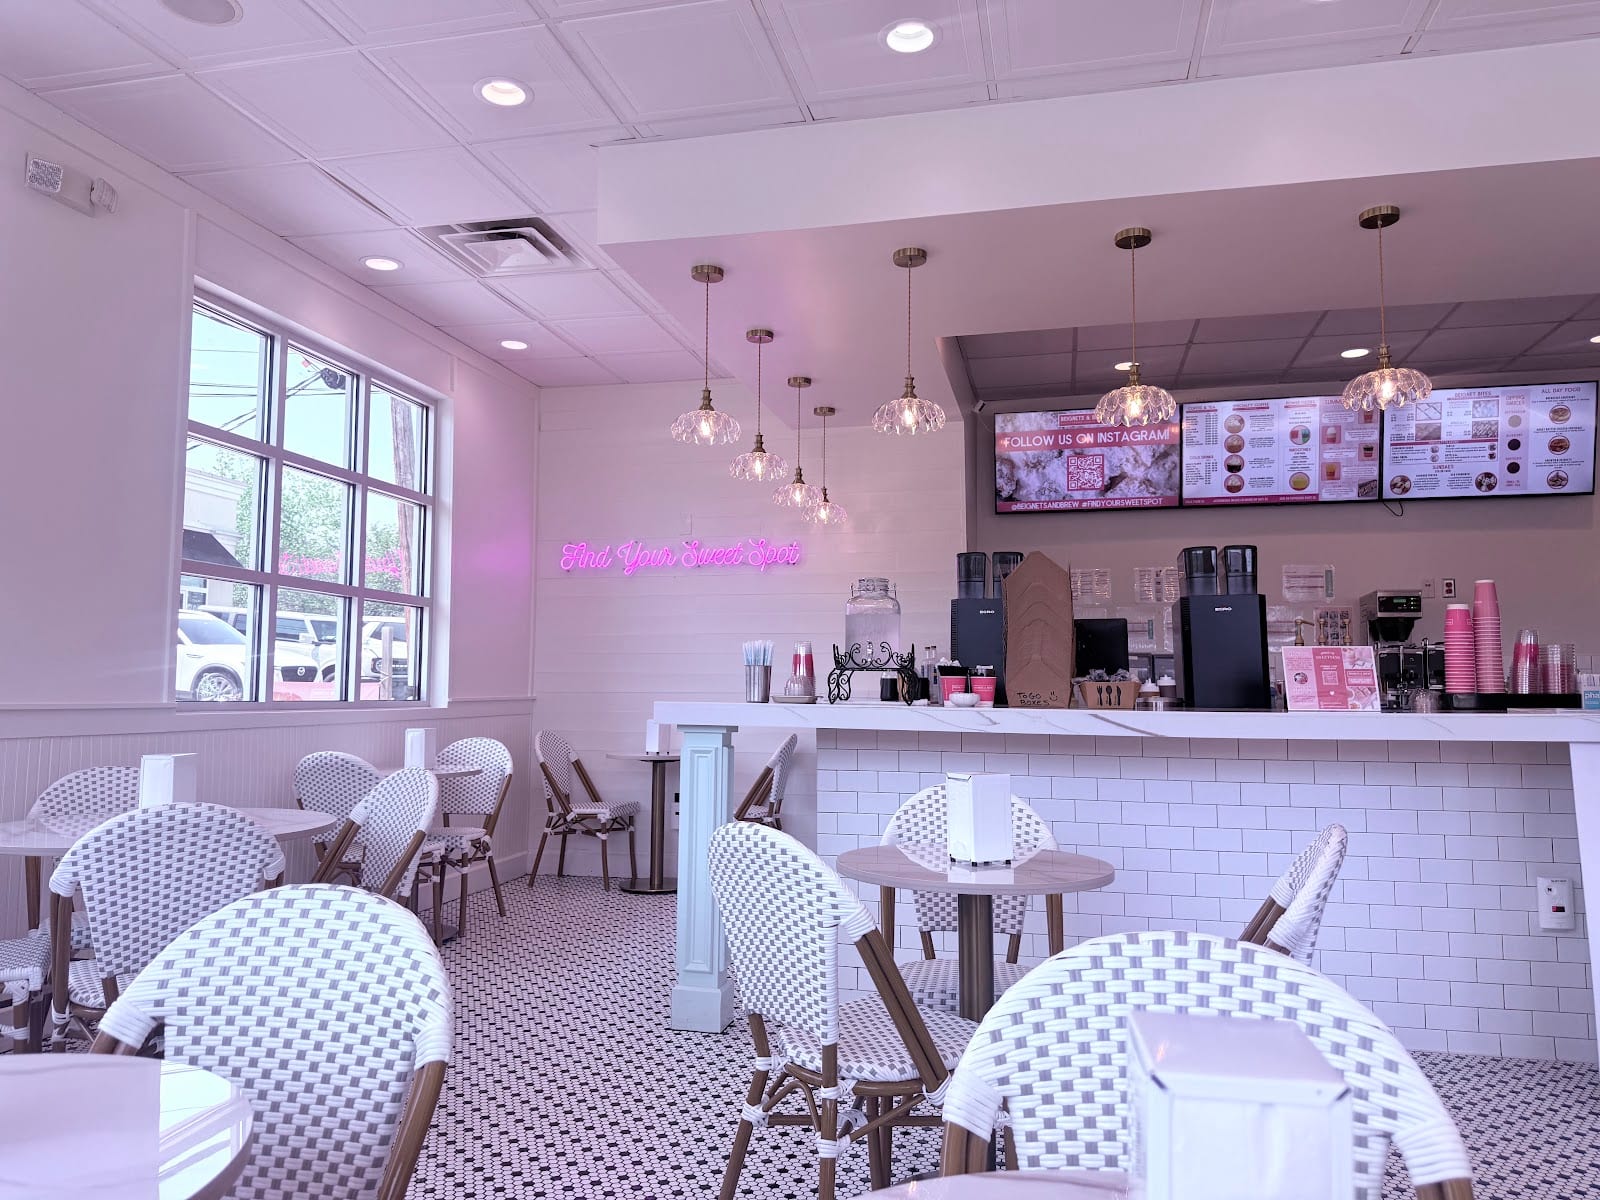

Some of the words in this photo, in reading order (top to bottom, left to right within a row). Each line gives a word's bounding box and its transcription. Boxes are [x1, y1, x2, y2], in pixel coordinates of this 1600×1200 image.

[1004, 435, 1055, 448] FOLLOW
[1058, 433, 1073, 445] US
[1075, 432, 1095, 445] ON
[1011, 501, 1080, 512] @BEIGNETSANDBREW
[1081, 497, 1164, 510] #FINDYOURSWEETSPOT
[560, 542, 613, 571] Find
[617, 539, 677, 576] Your
[681, 539, 744, 568] Sweet
[748, 537, 801, 572] Spot
